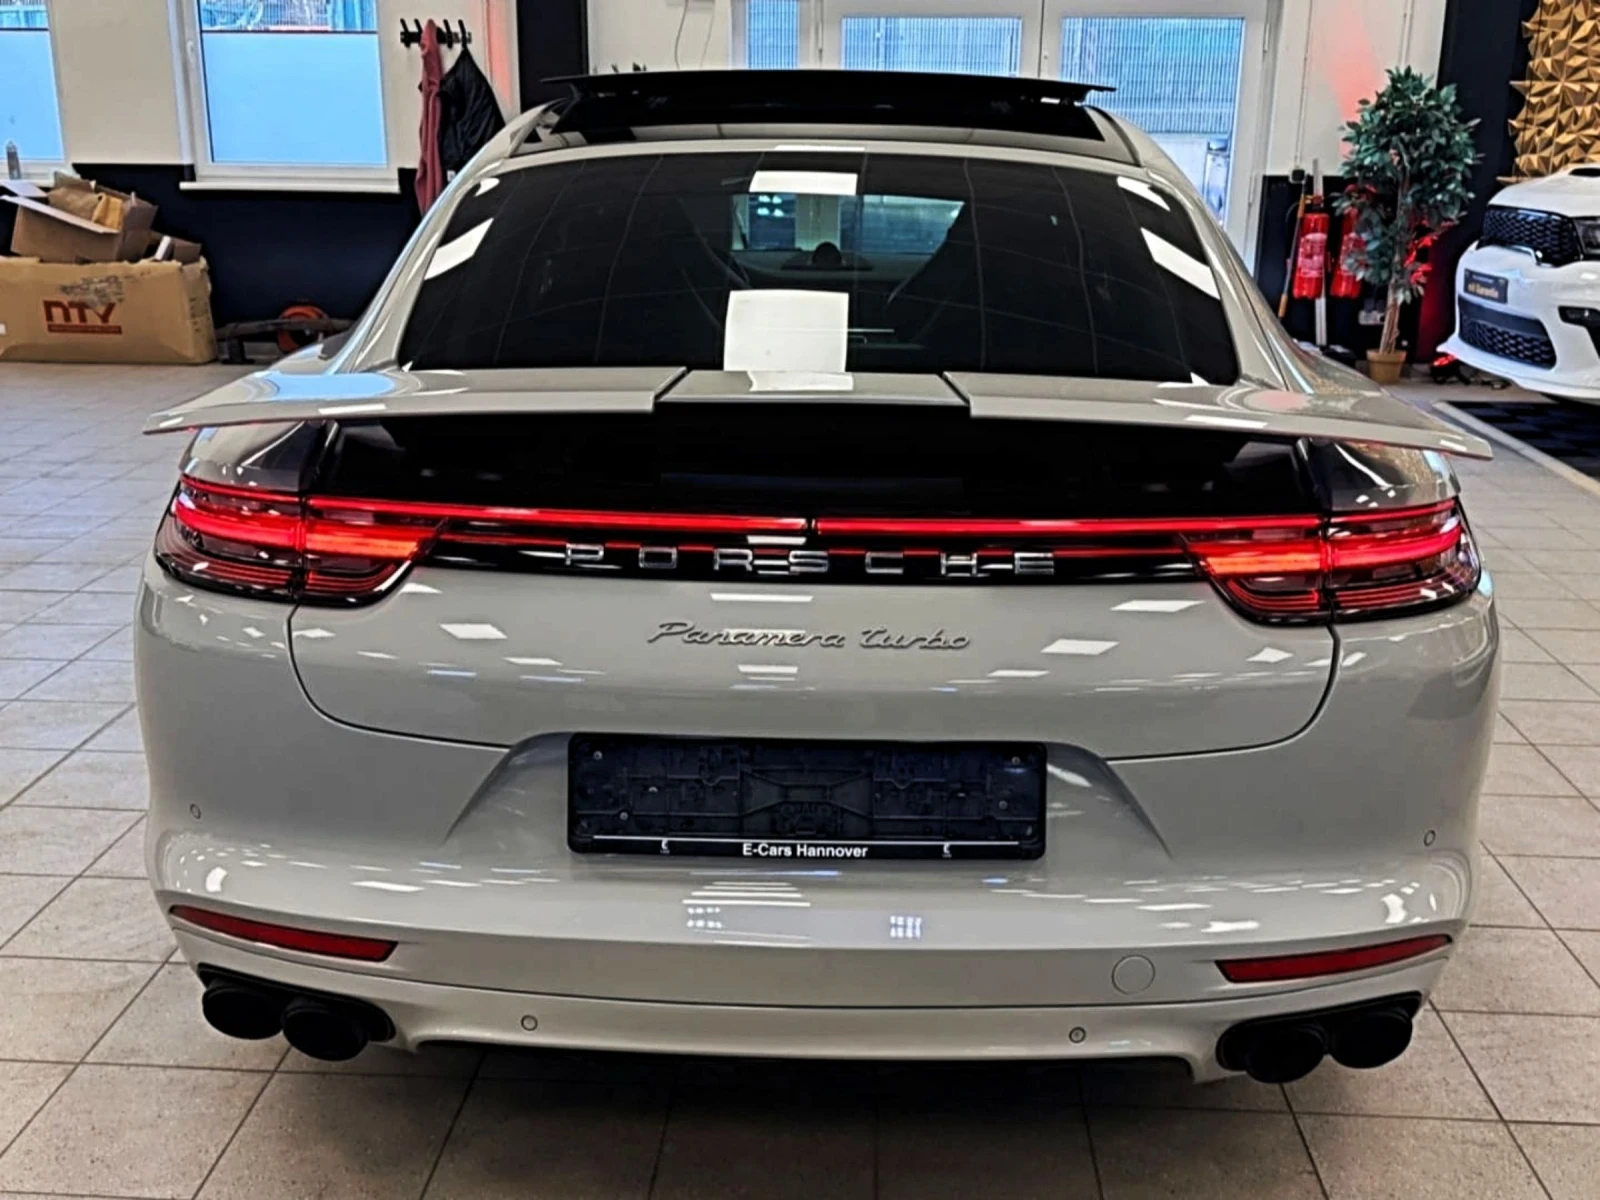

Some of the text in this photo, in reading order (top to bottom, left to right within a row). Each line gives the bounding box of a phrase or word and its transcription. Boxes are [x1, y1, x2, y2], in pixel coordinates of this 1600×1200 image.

[566, 543, 1055, 575] PORSCHE
[647, 621, 845, 647] Panamera
[742, 842, 869, 858] E-Cars Hannover
